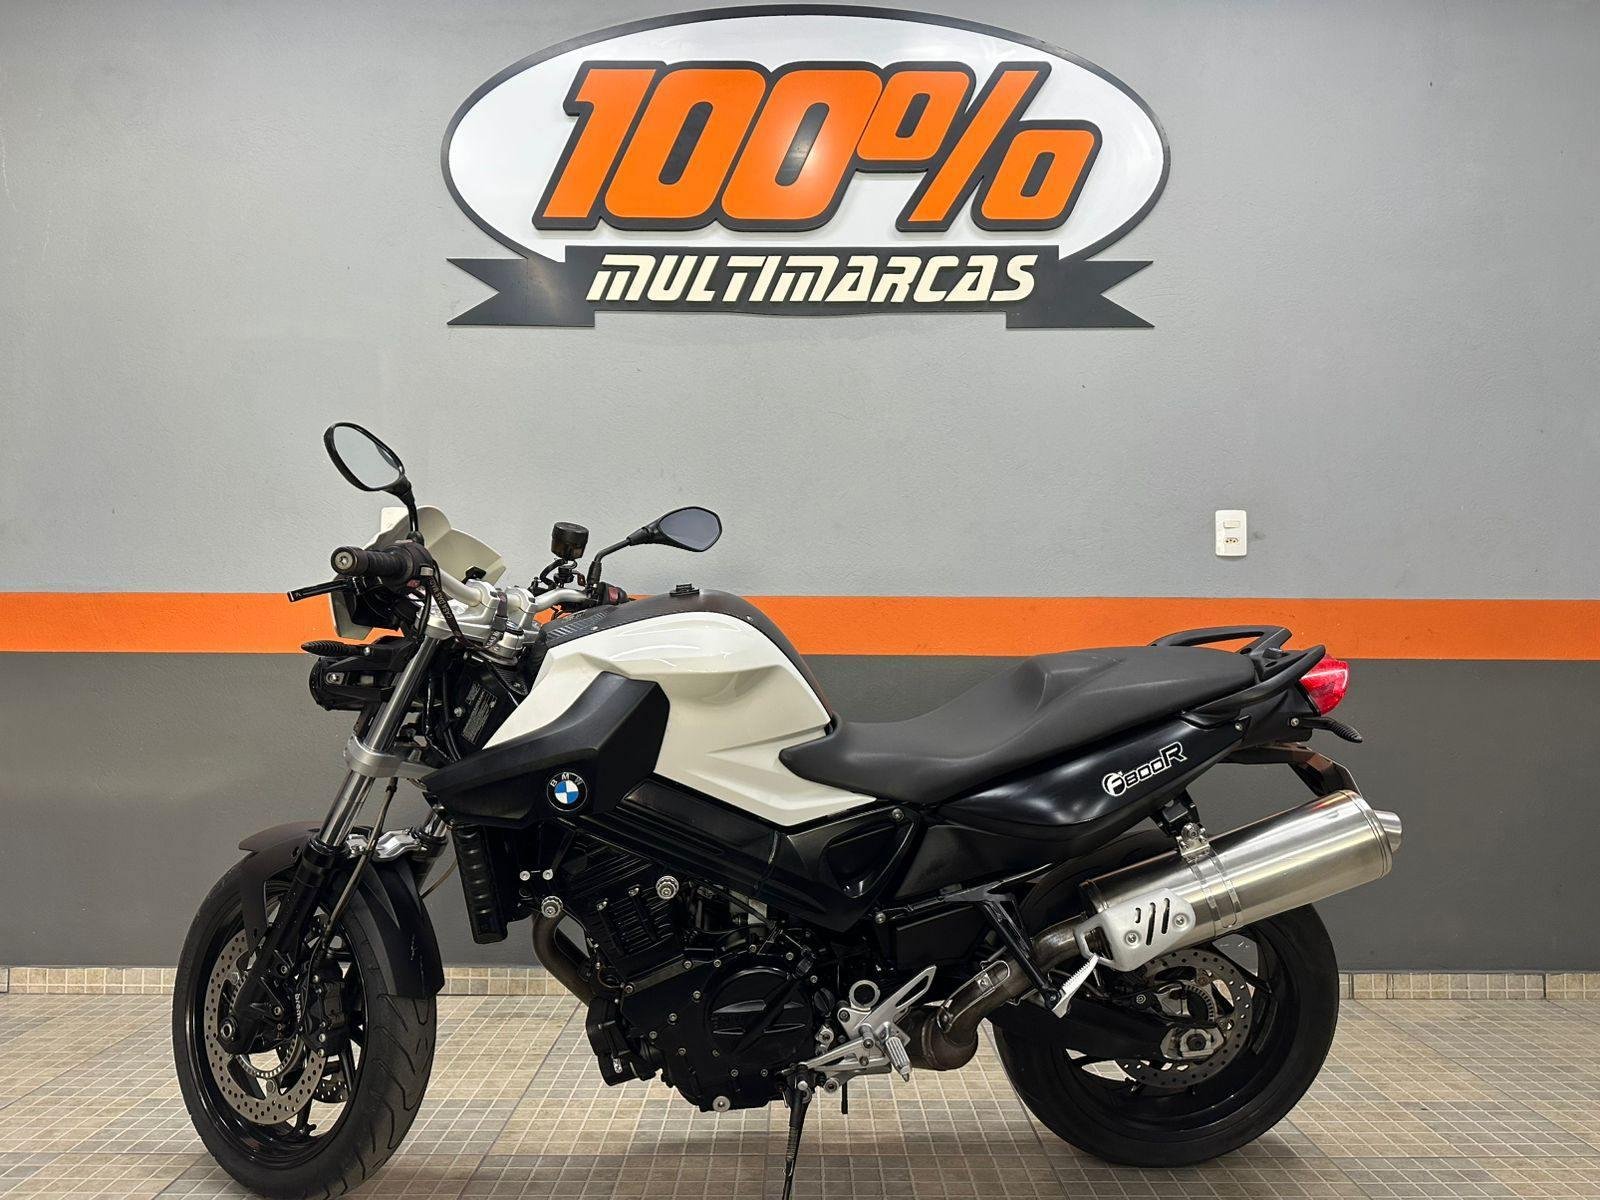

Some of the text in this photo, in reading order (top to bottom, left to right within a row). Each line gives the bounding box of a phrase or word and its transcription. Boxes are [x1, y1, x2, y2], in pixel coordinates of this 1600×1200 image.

[536, 64, 1099, 228] 100%
[585, 253, 1039, 304] MULTIMARCAS
[550, 772, 583, 787] BMW
